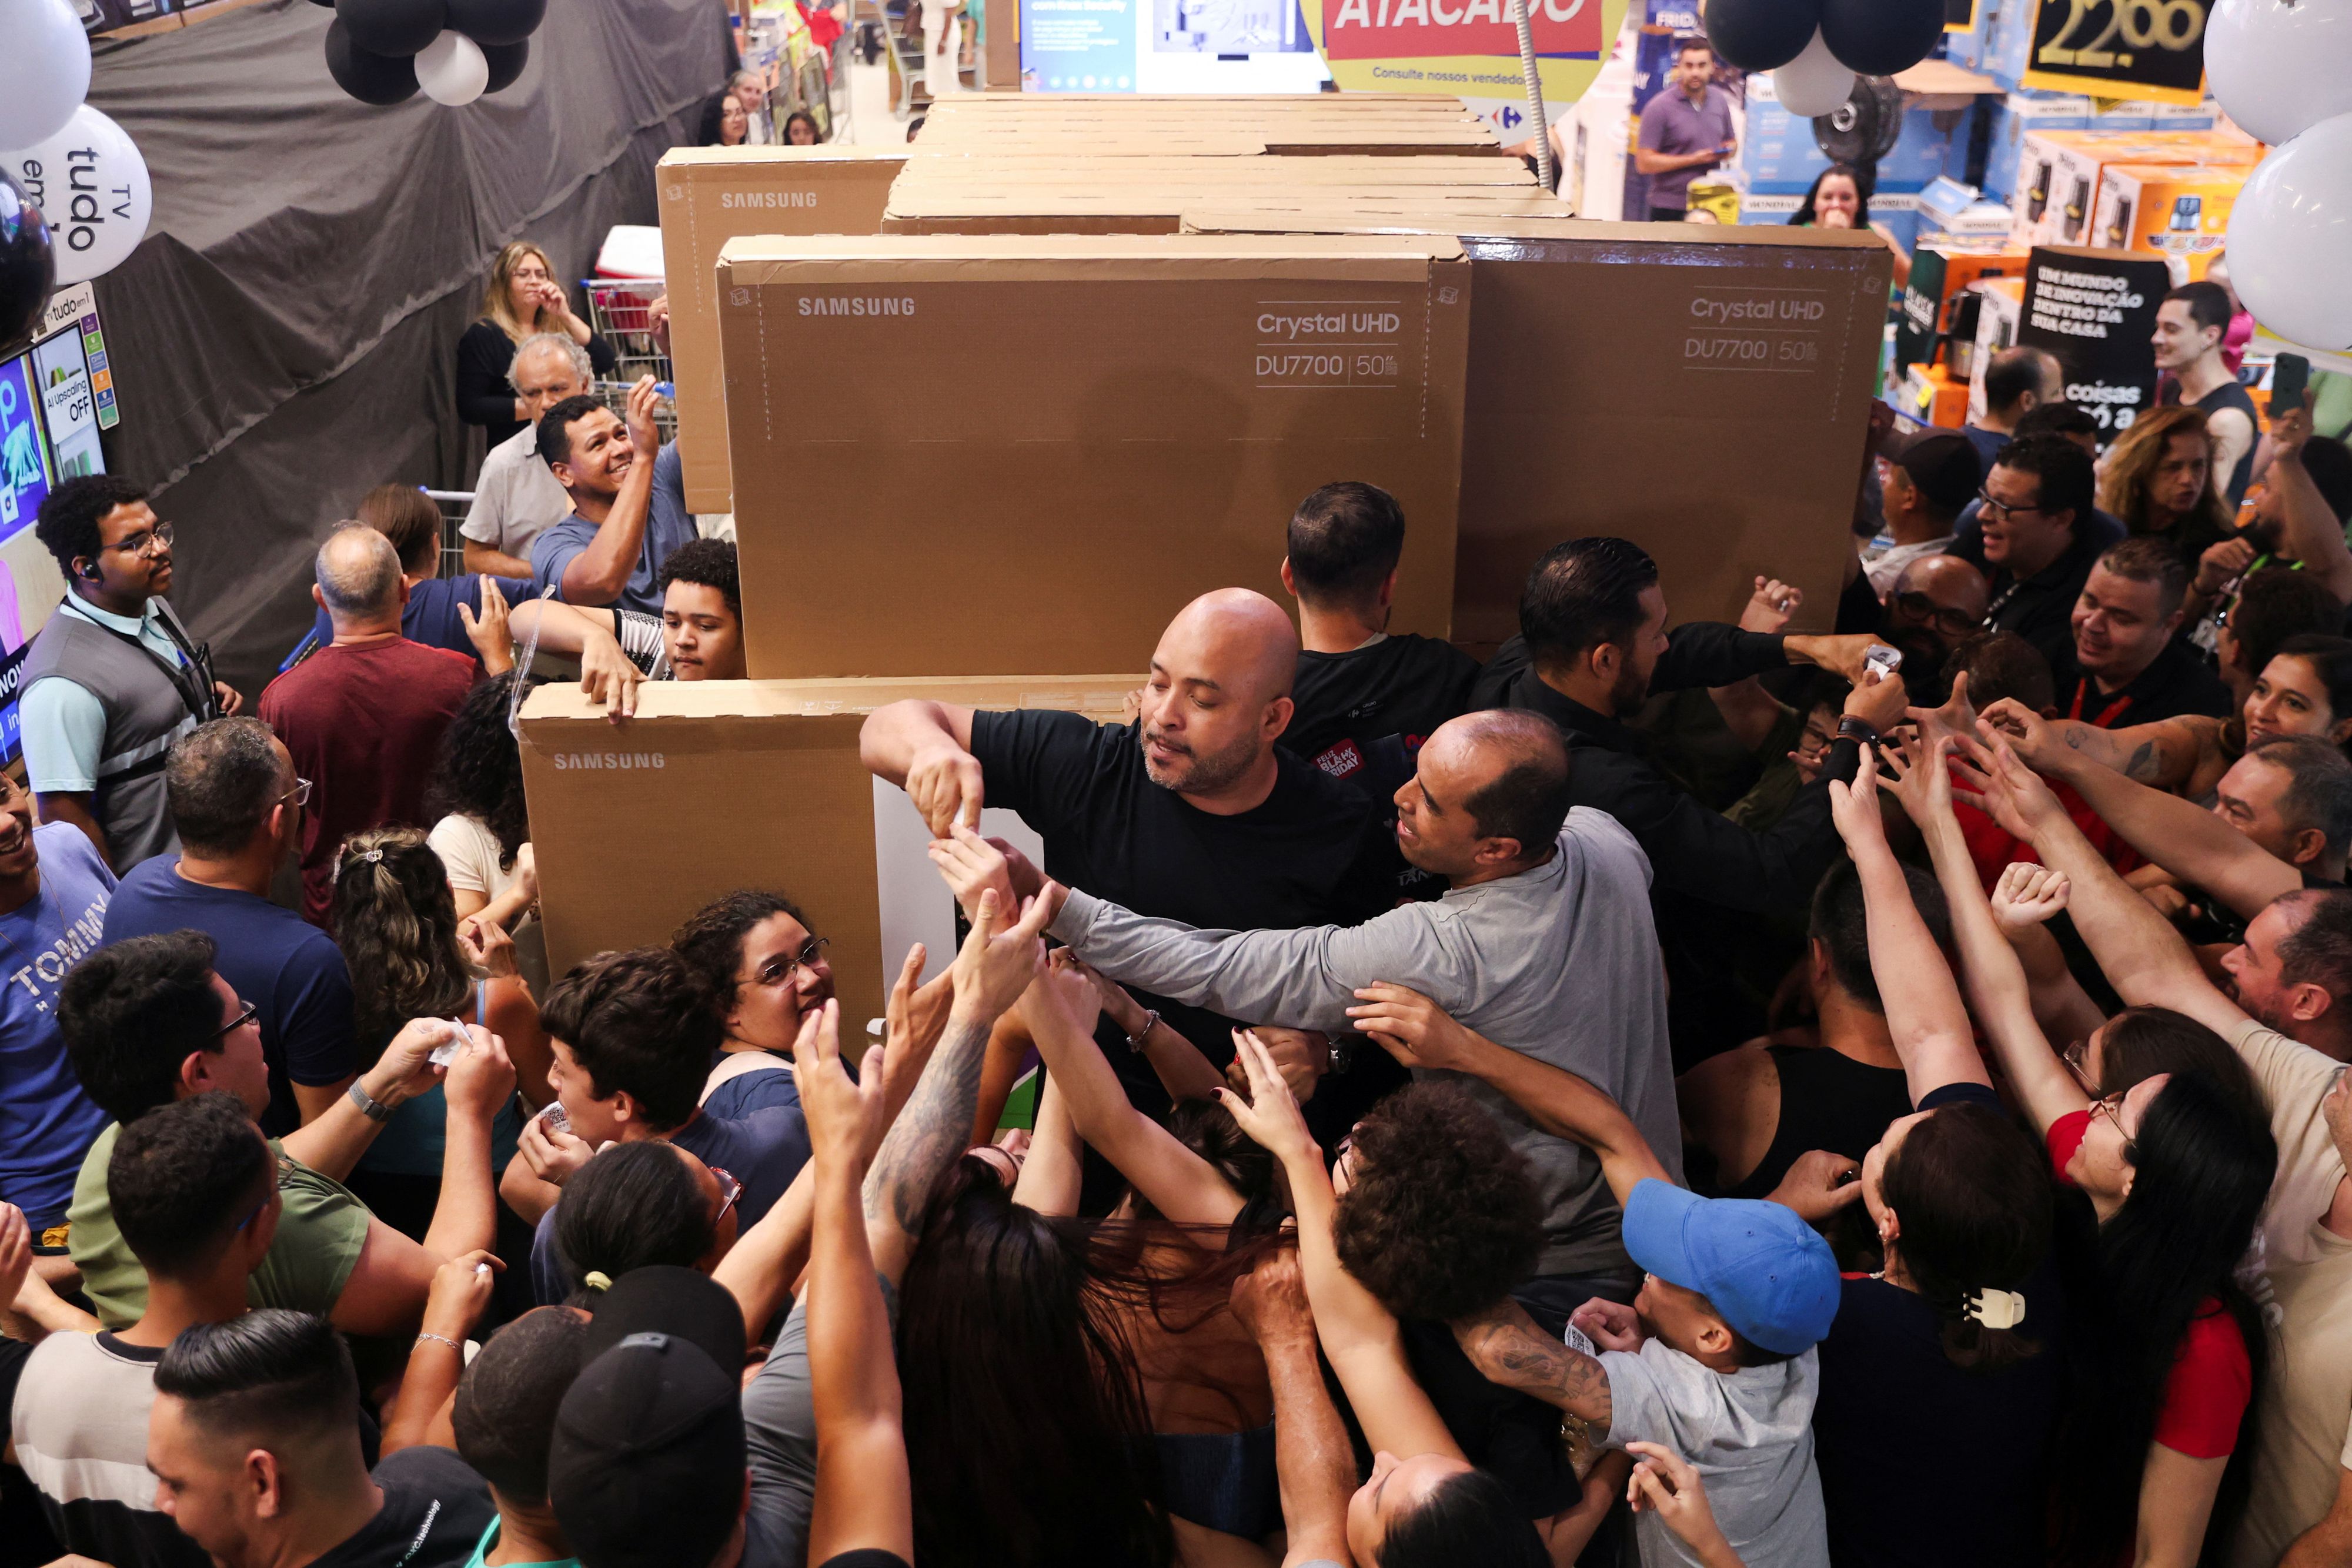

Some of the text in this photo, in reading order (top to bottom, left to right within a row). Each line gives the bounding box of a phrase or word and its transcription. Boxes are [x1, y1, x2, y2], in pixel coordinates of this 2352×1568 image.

[1373, 66, 1424, 81] Consulte
[1427, 71, 1468, 83] nossos
[67, 146, 105, 252] tudo
[111, 183, 131, 220] TV
[721, 192, 817, 208] SAMSUNG
[2037, 265, 2129, 292] UM MUNDO
[798, 296, 916, 316] SAMSUNG
[2035, 280, 2144, 310] DE INOVAÇÃO
[52, 298, 76, 322] tudo
[76, 297, 86, 308] em
[1690, 298, 1824, 323] Crystal UHD
[2032, 296, 2124, 323] DENTRO DA
[1257, 313, 1401, 340] Crystal UHD
[2030, 312, 2109, 339] SUA CASA
[1684, 338, 1767, 359] DU7700
[1256, 355, 1343, 376] DU7700
[47, 396, 55, 410] AI
[55, 379, 87, 407] Upscaling
[2065, 379, 2141, 404] coisas
[69, 396, 89, 422] OFF
[554, 752, 665, 770] SAMSUNG
[1317, 750, 1336, 764] FELIZ
[1329, 755, 1359, 777] RIDAY
[1396, 870, 1433, 887] TAN
[9, 892, 107, 997] TOMMY
